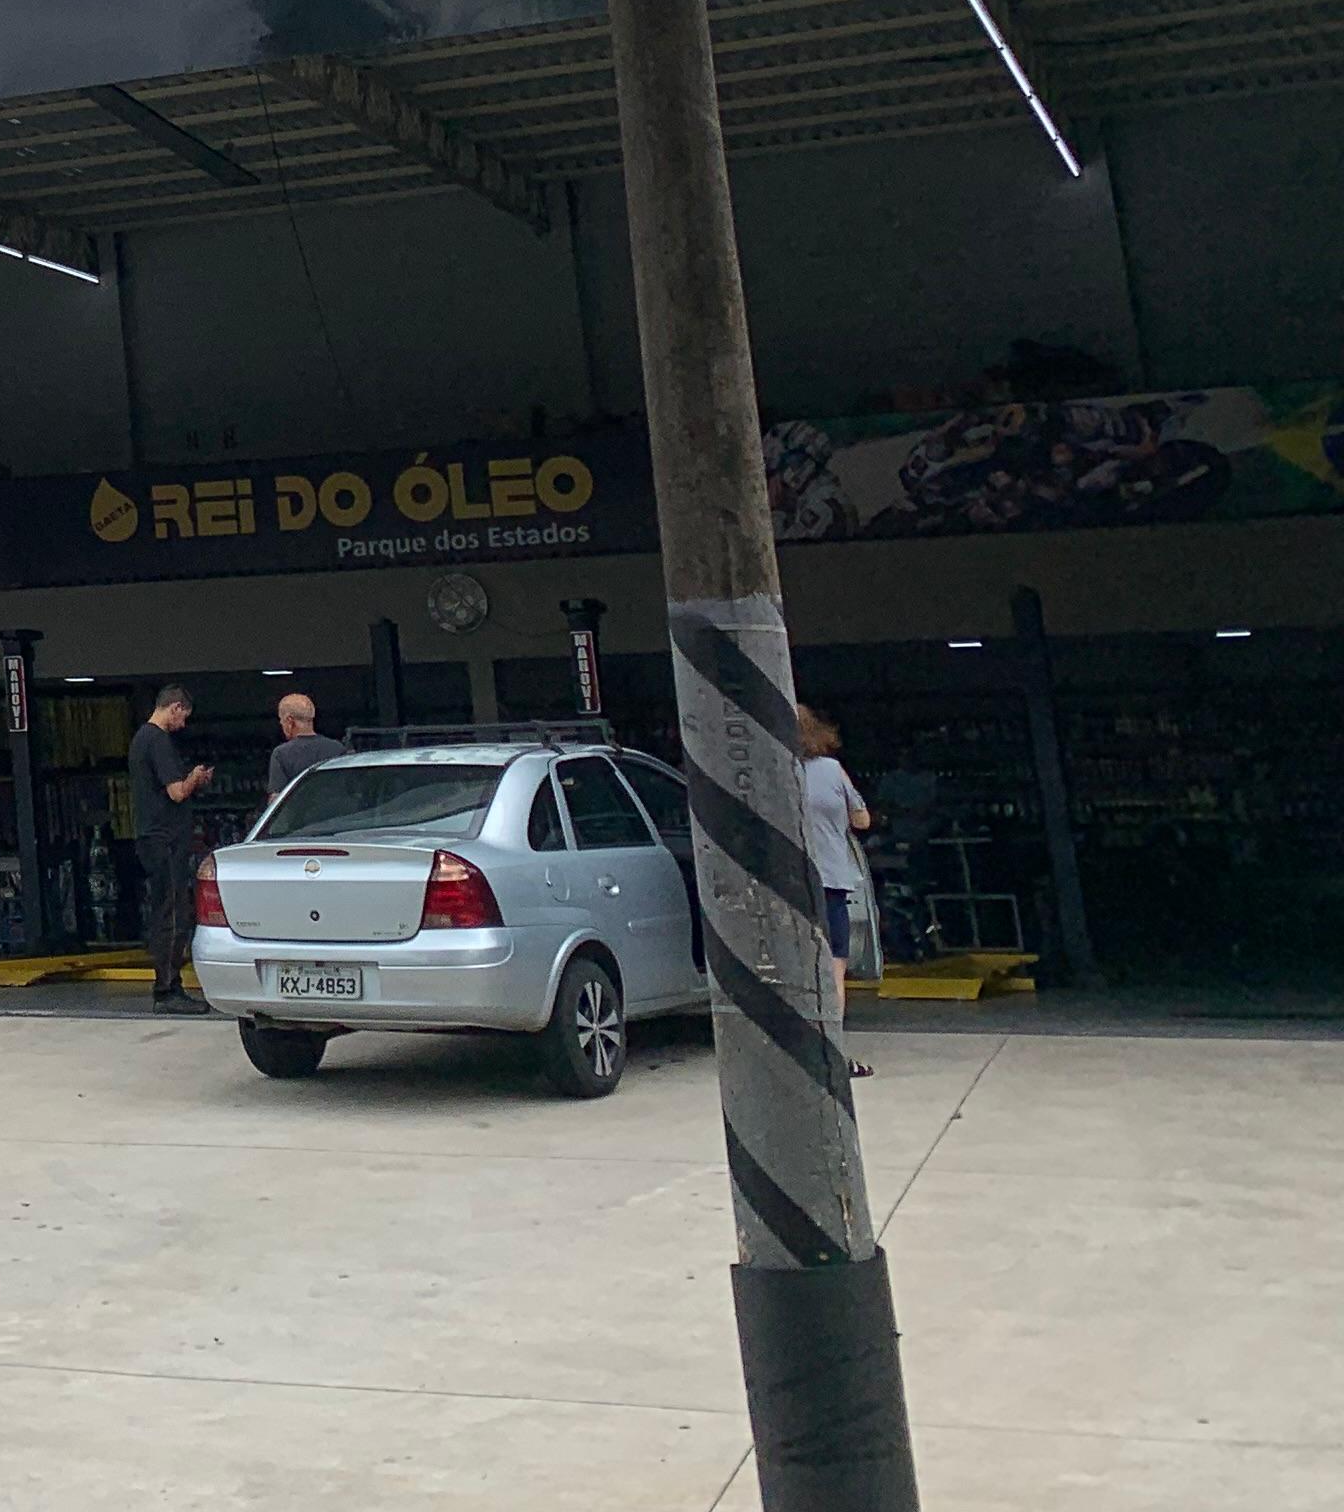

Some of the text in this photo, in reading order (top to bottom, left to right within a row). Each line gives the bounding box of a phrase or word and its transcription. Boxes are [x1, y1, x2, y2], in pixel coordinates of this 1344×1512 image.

[151, 451, 594, 540] REI DO ÓLEO
[337, 522, 590, 562] Parque dos Estados
